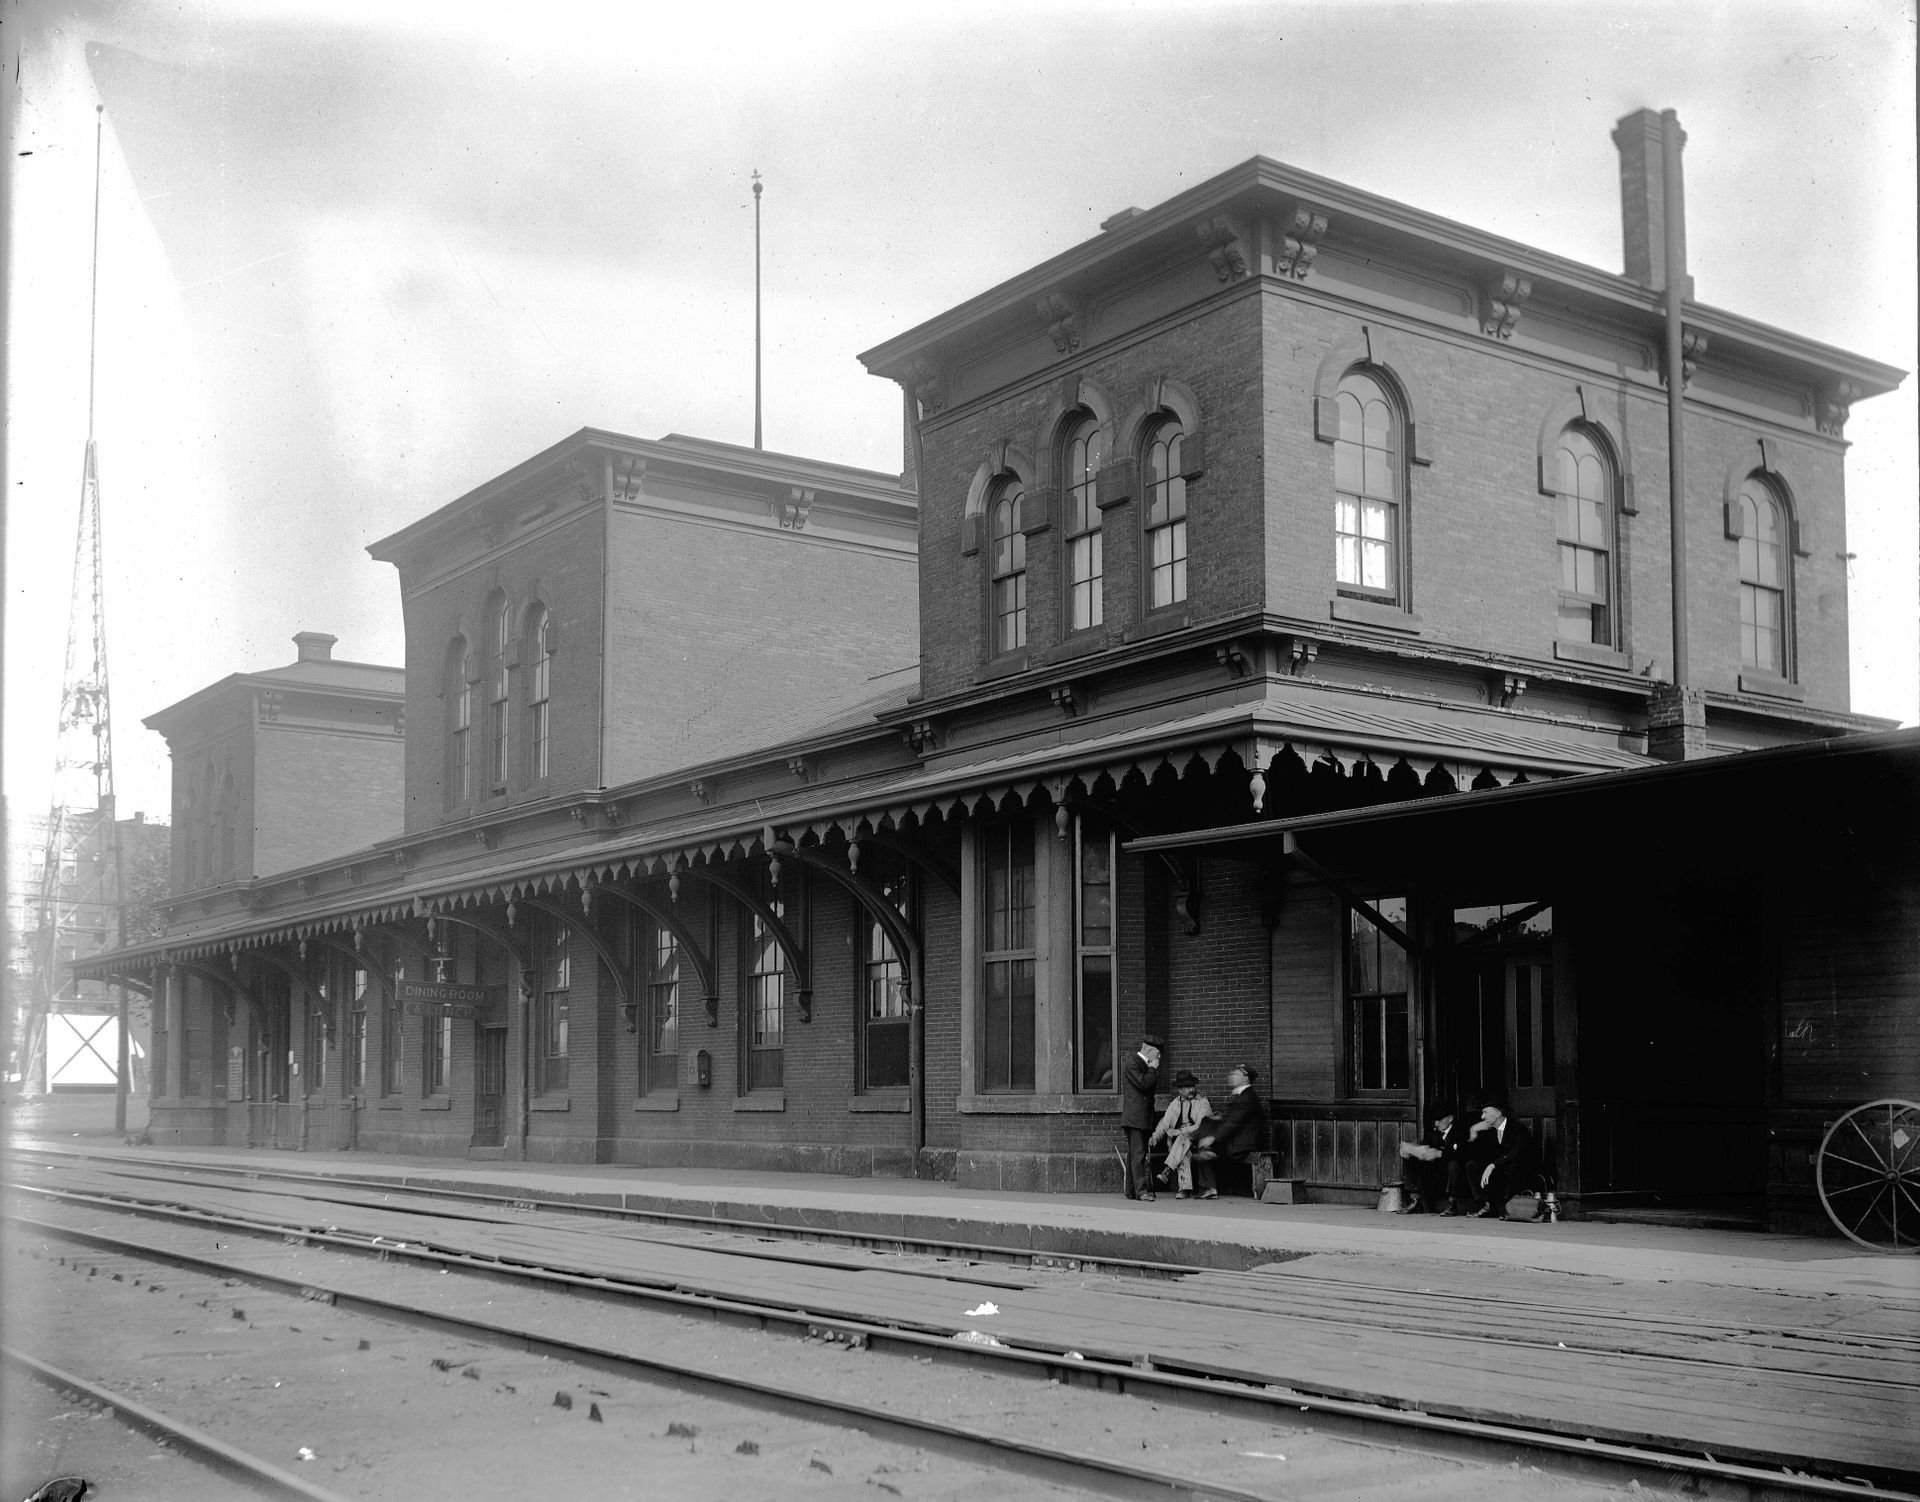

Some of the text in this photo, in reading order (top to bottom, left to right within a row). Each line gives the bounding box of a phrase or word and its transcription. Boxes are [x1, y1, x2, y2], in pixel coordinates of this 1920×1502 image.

[405, 985, 484, 1001] DINING ROOM
[427, 1005, 472, 1018] LUNCH
